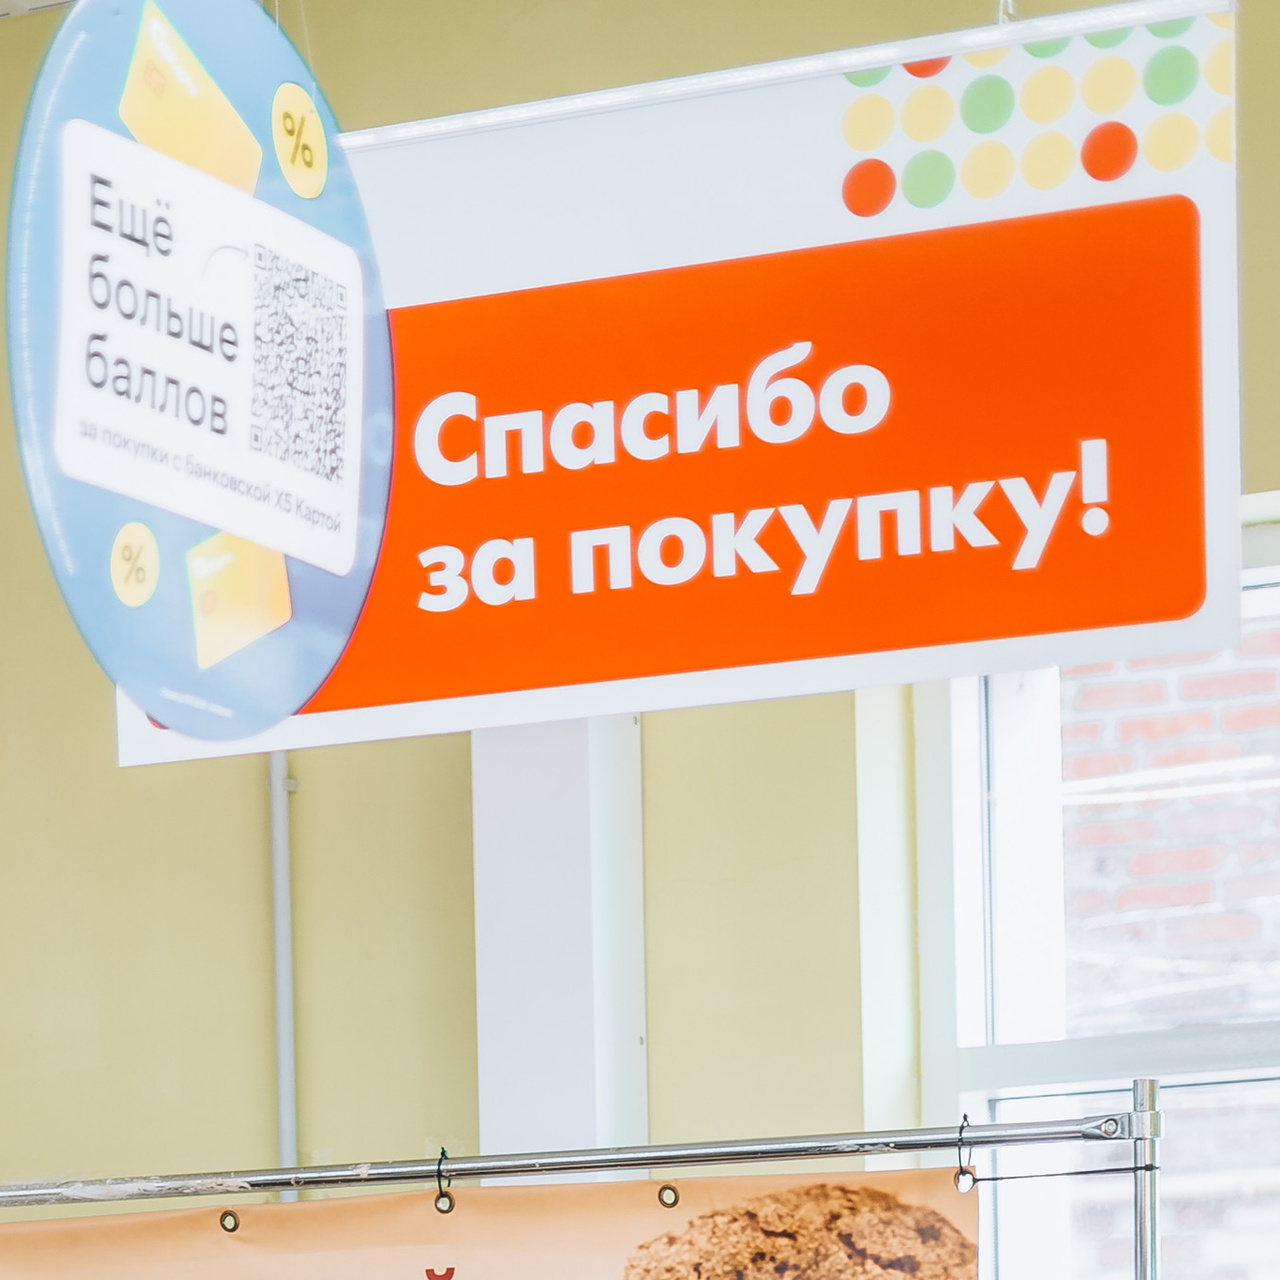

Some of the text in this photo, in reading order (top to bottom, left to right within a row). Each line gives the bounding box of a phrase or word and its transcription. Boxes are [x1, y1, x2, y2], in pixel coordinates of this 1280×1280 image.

[90, 172, 174, 258] Ещё
[88, 253, 239, 363] больше
[85, 332, 228, 436] баллов
[413, 340, 891, 486] Спасибо
[78, 419, 98, 440] за
[102, 428, 169, 467] покупки
[185, 453, 271, 503] банковской
[295, 499, 342, 534] Картой
[417, 437, 1111, 613] за покупку!
